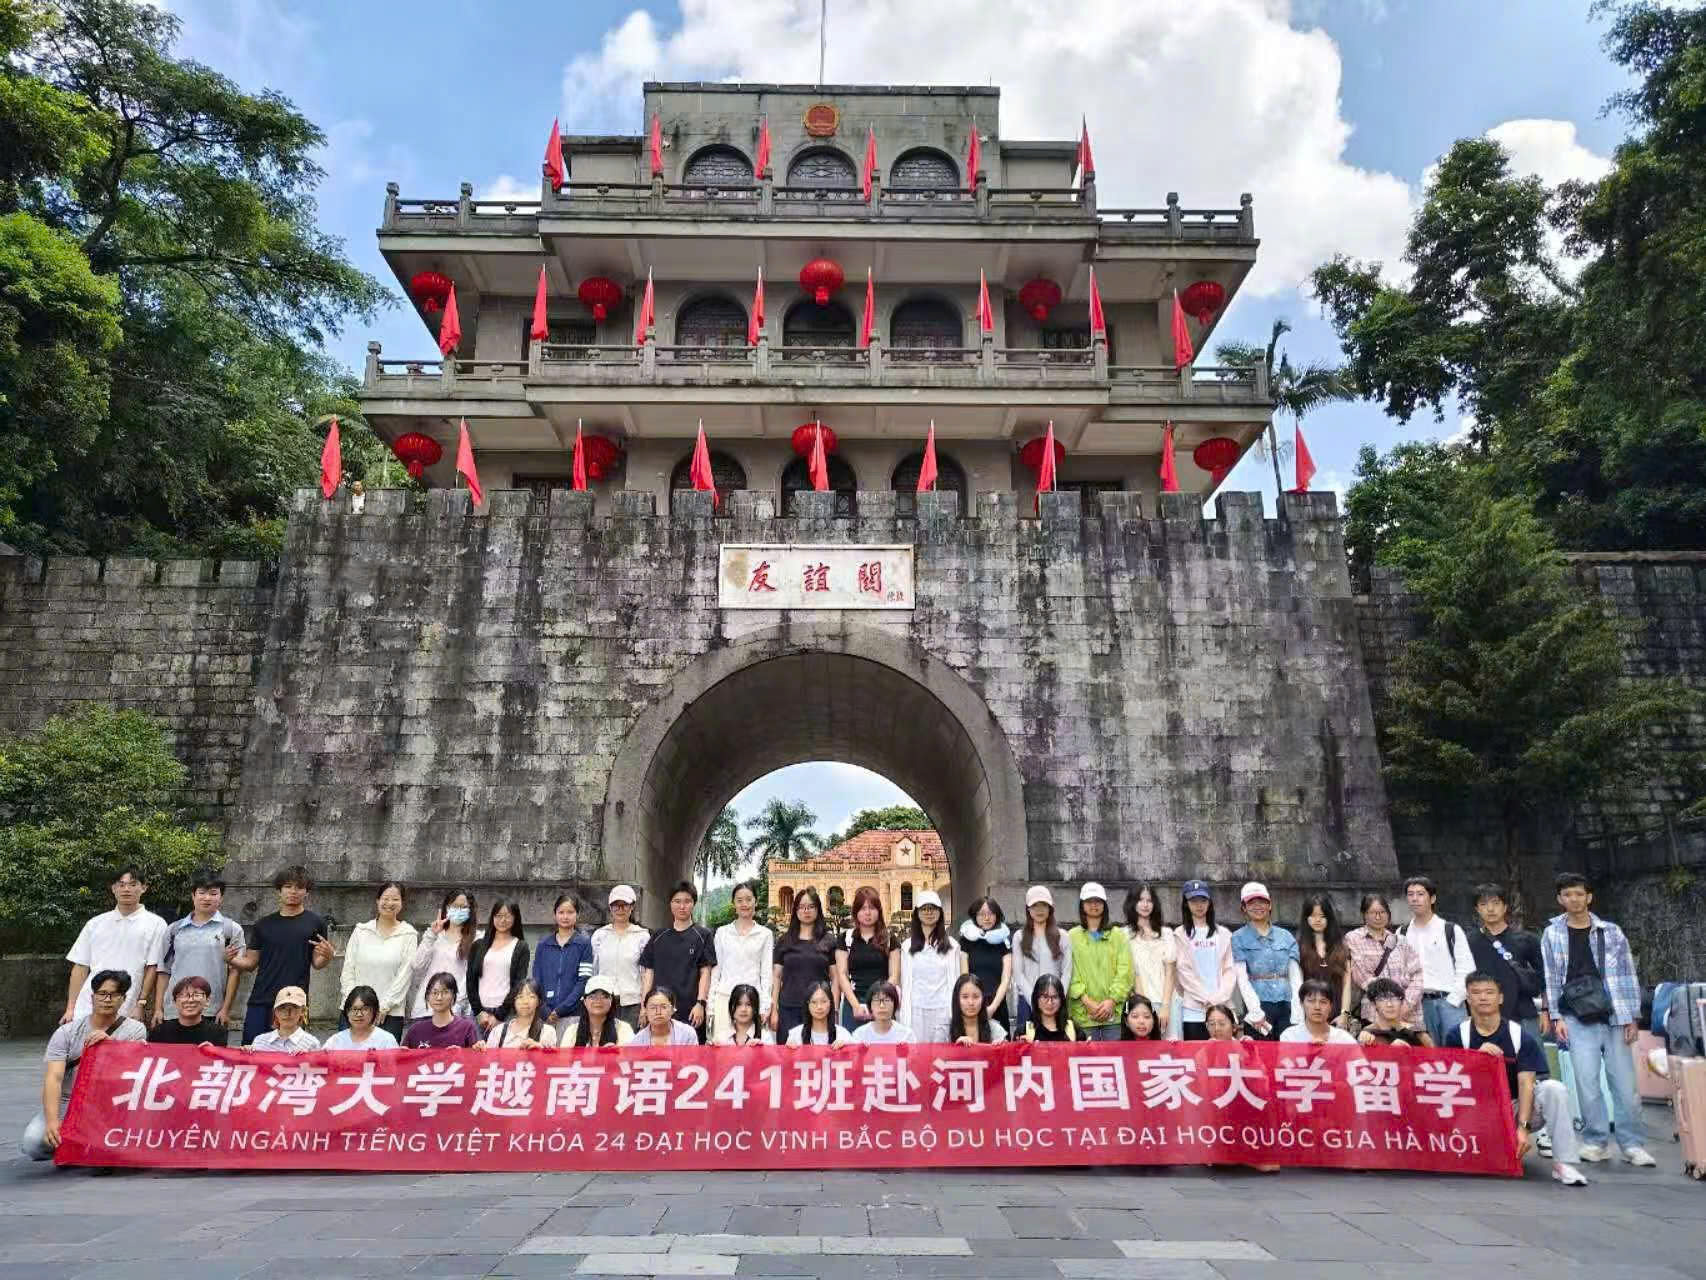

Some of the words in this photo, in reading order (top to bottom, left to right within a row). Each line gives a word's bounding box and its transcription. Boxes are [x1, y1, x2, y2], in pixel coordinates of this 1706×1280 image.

[110, 1053, 1477, 1118] 北部湾大学越南语241班赴河内国家大学留学
[105, 1125, 221, 1148] CHUYÊN
[231, 1125, 330, 1151] NGÀNH
[438, 1127, 501, 1156] VIỆT
[509, 1127, 585, 1152] KHÓA
[595, 1132, 626, 1151] 24
[635, 1132, 685, 1154] ĐẠI
[695, 1131, 752, 1154] HỌC
[761, 1130, 828, 1154] VỊNH
[840, 1124, 892, 1150] BẮC
[902, 1123, 937, 1152] BỘ
[948, 1129, 985, 1148] DU
[996, 1127, 1054, 1152] HỌC
[1061, 1127, 1109, 1152] TẠI
[1117, 1127, 1167, 1150] ĐẠI
[1178, 1126, 1234, 1149] HỌC
[1323, 1129, 1376, 1149] GIA
[1385, 1126, 1422, 1151] HÀ
[1429, 1128, 1479, 1158] NỘI
